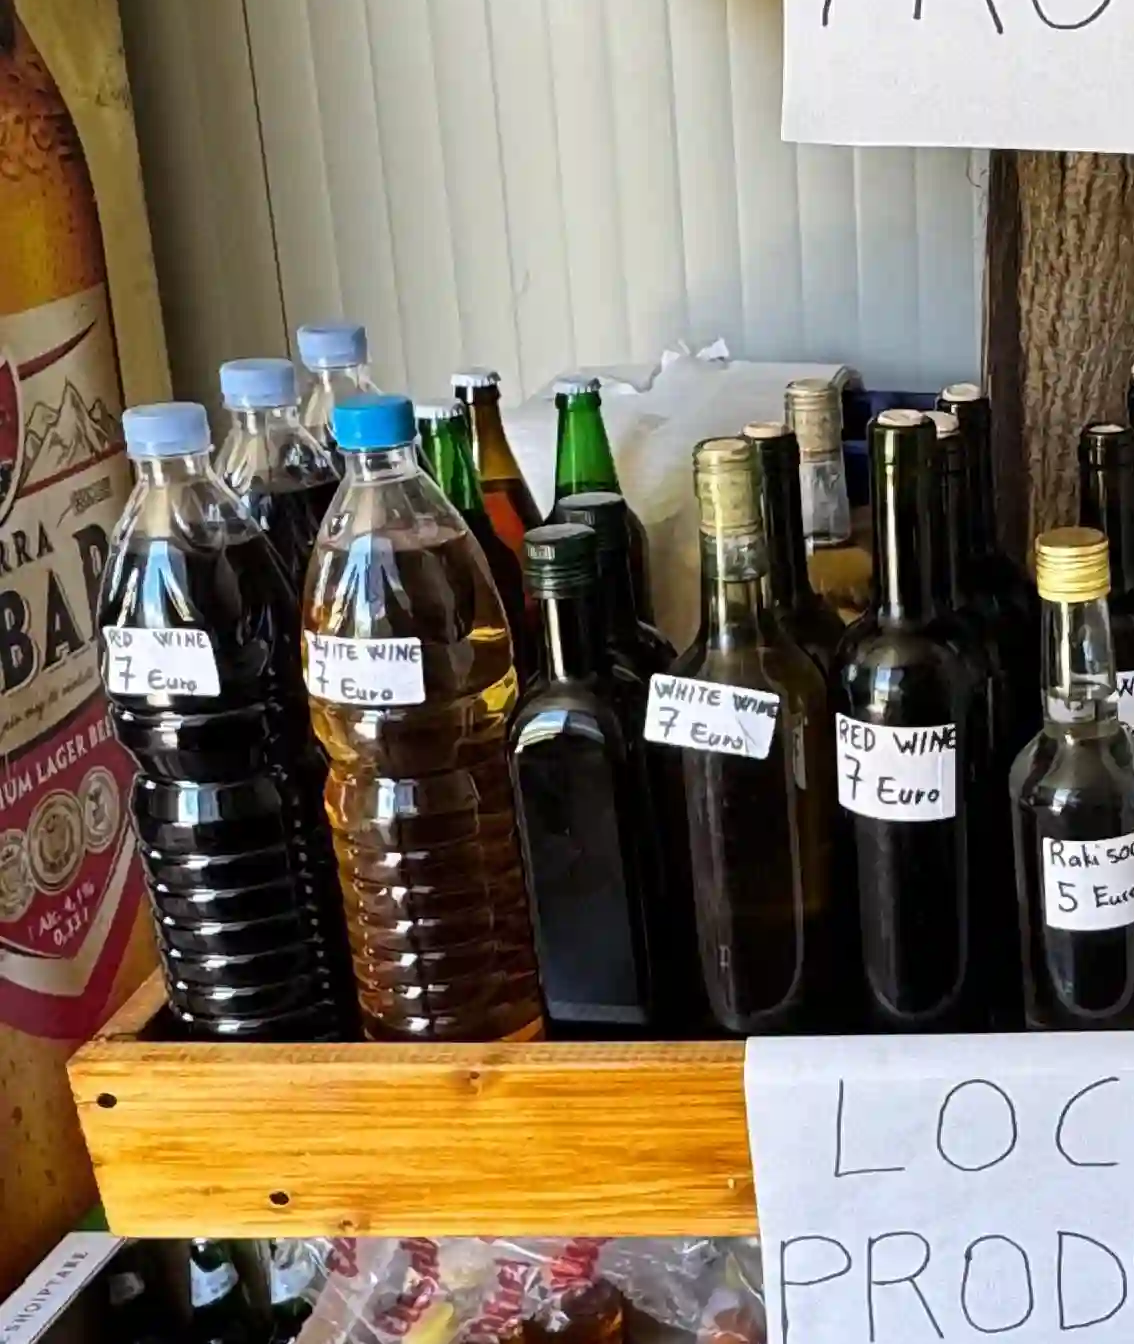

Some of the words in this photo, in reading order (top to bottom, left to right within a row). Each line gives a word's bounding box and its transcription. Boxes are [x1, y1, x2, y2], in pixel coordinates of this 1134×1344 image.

[109, 629, 132, 647] RD
[153, 632, 208, 648] WINE
[367, 643, 421, 663] WINE
[115, 656, 136, 691] 7
[148, 669, 197, 693] Euro
[316, 660, 329, 693] 7
[341, 678, 393, 700] Euro
[655, 678, 721, 706] WHITE
[733, 692, 779, 718] WINE
[659, 706, 680, 739] 7
[690, 722, 743, 749] Euro
[840, 719, 875, 752] RED
[893, 727, 956, 755] WINE
[37, 734, 87, 782] LAGER
[845, 754, 862, 800] 7
[877, 776, 940, 805] Euro
[1050, 841, 1100, 868] Raki
[1057, 881, 1078, 913] 5
